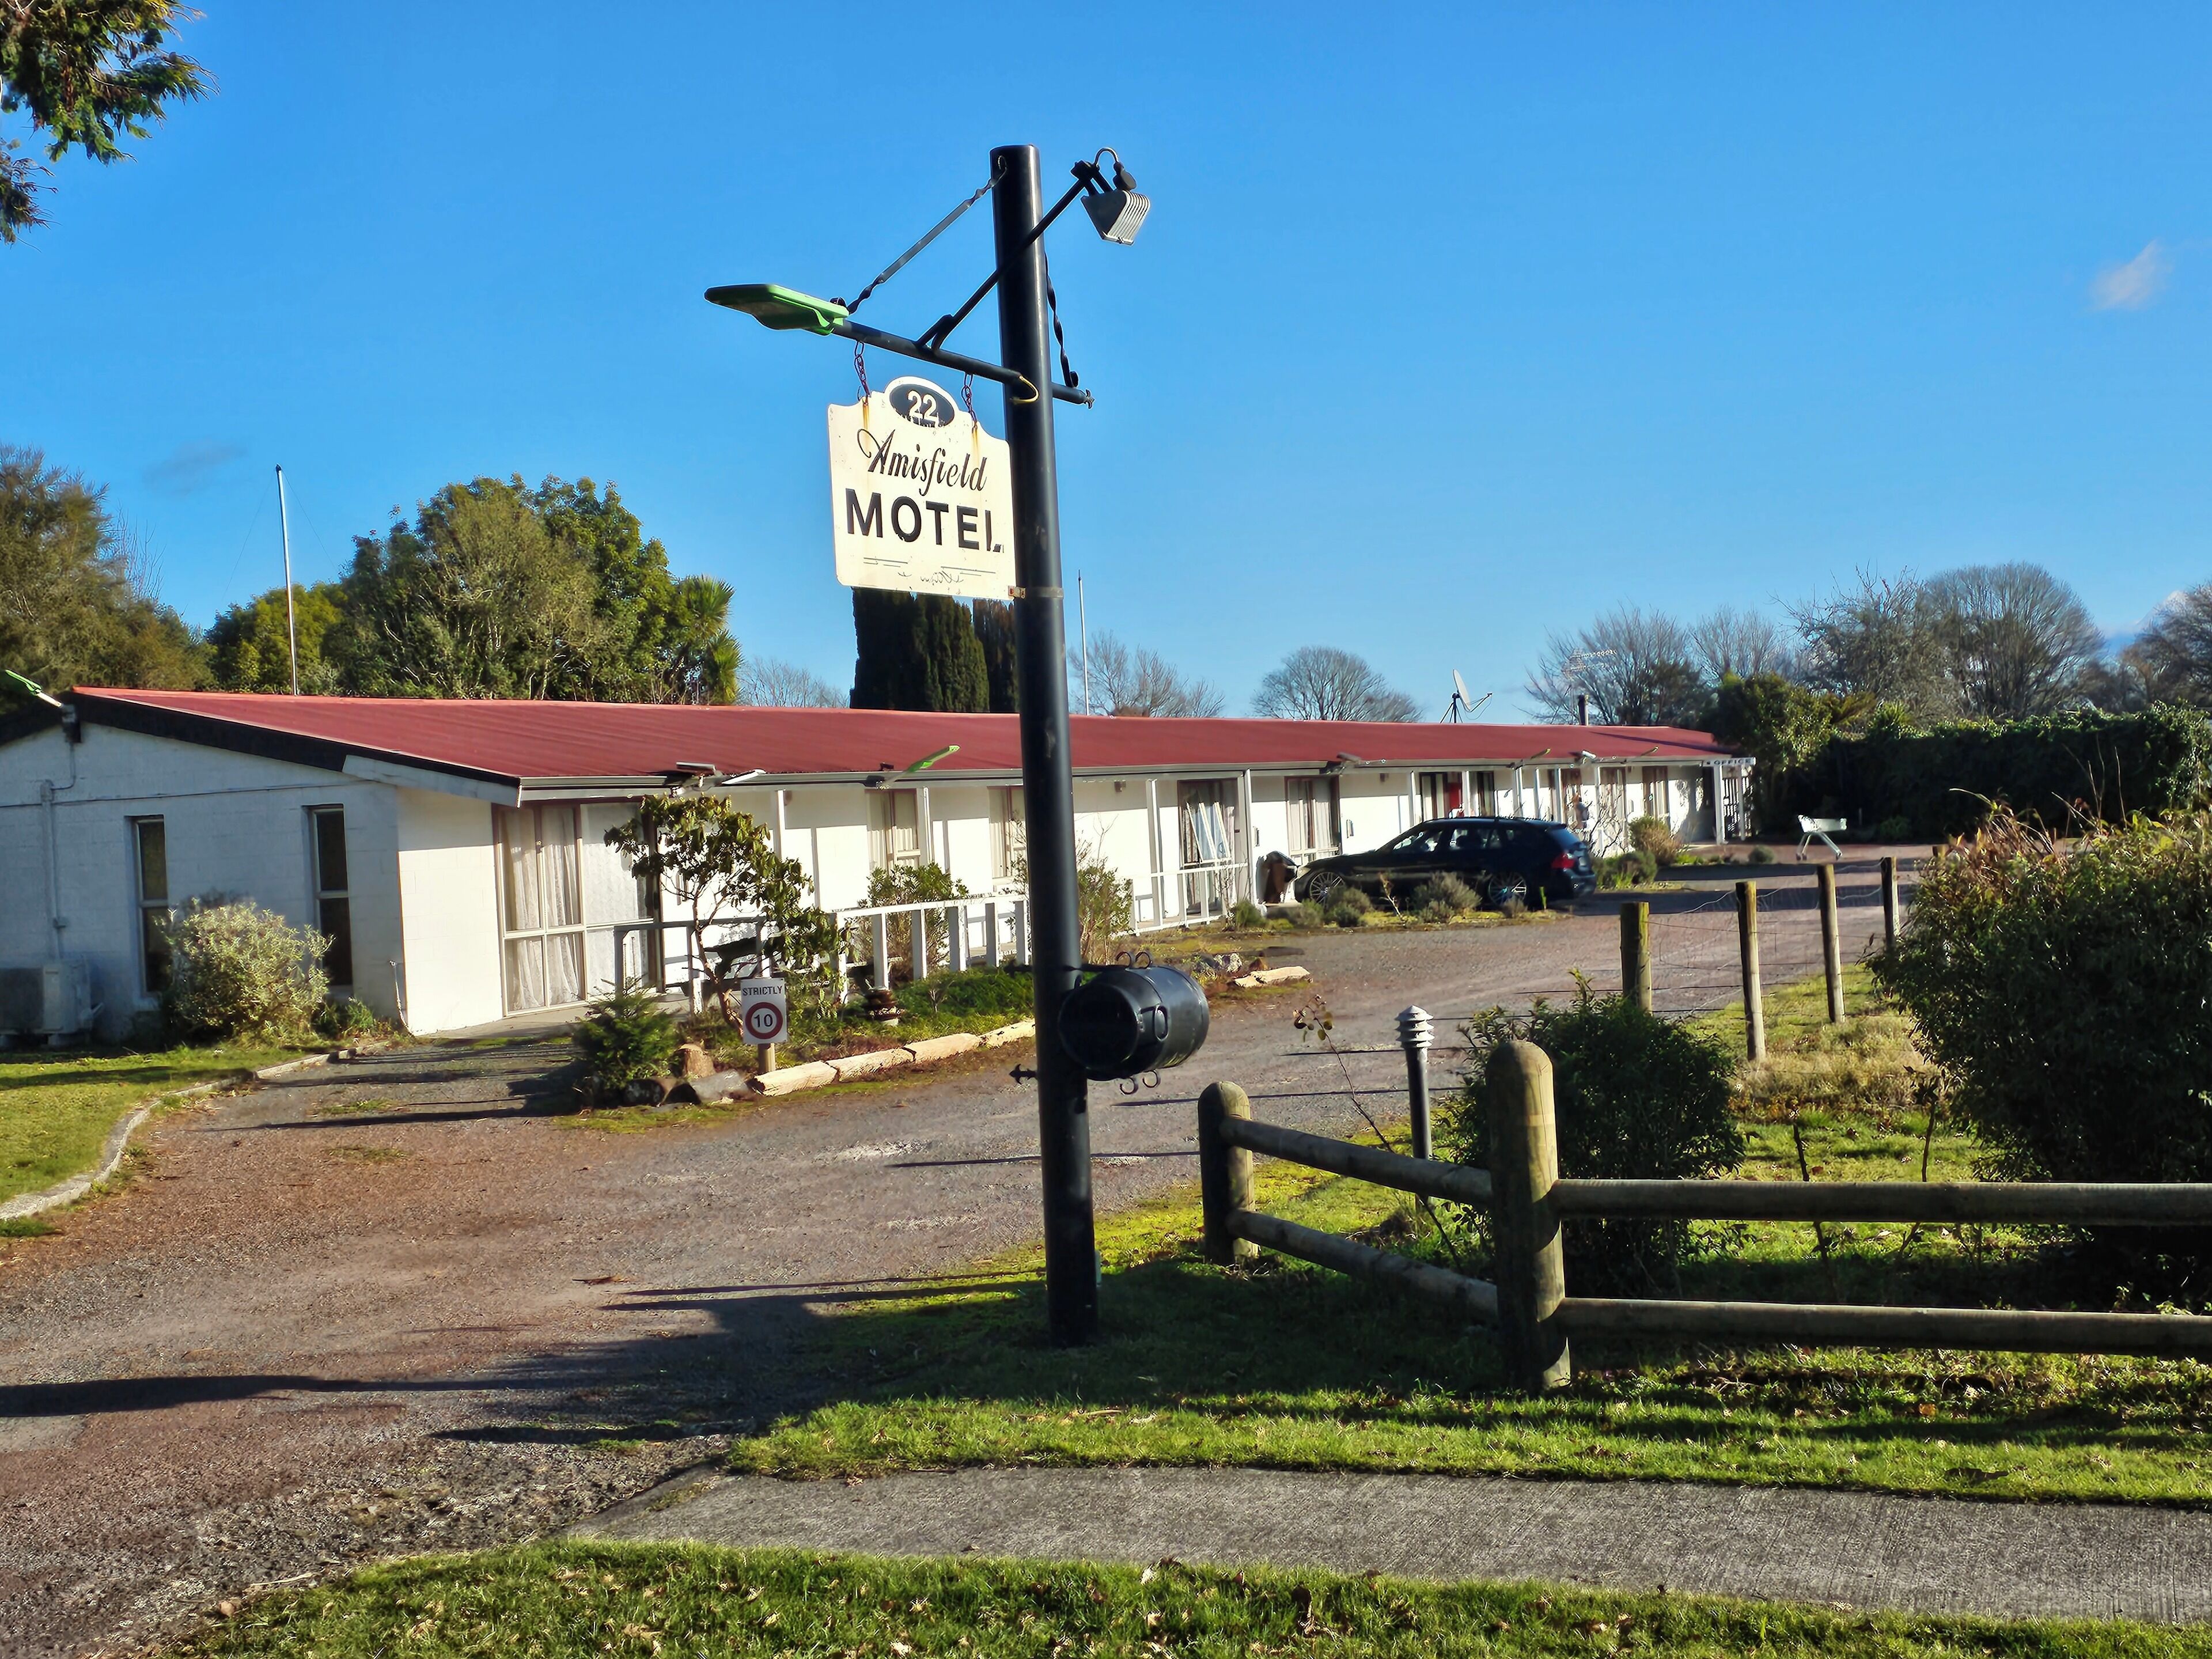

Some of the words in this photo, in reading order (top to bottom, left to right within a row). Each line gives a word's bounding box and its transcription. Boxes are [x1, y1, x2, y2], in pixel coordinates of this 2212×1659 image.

[907, 389, 938, 422] 22
[857, 429, 987, 496] Amisfield
[845, 488, 1004, 553] MOTEL
[742, 986, 782, 996] STRICTLY
[754, 1014, 773, 1028] 10
